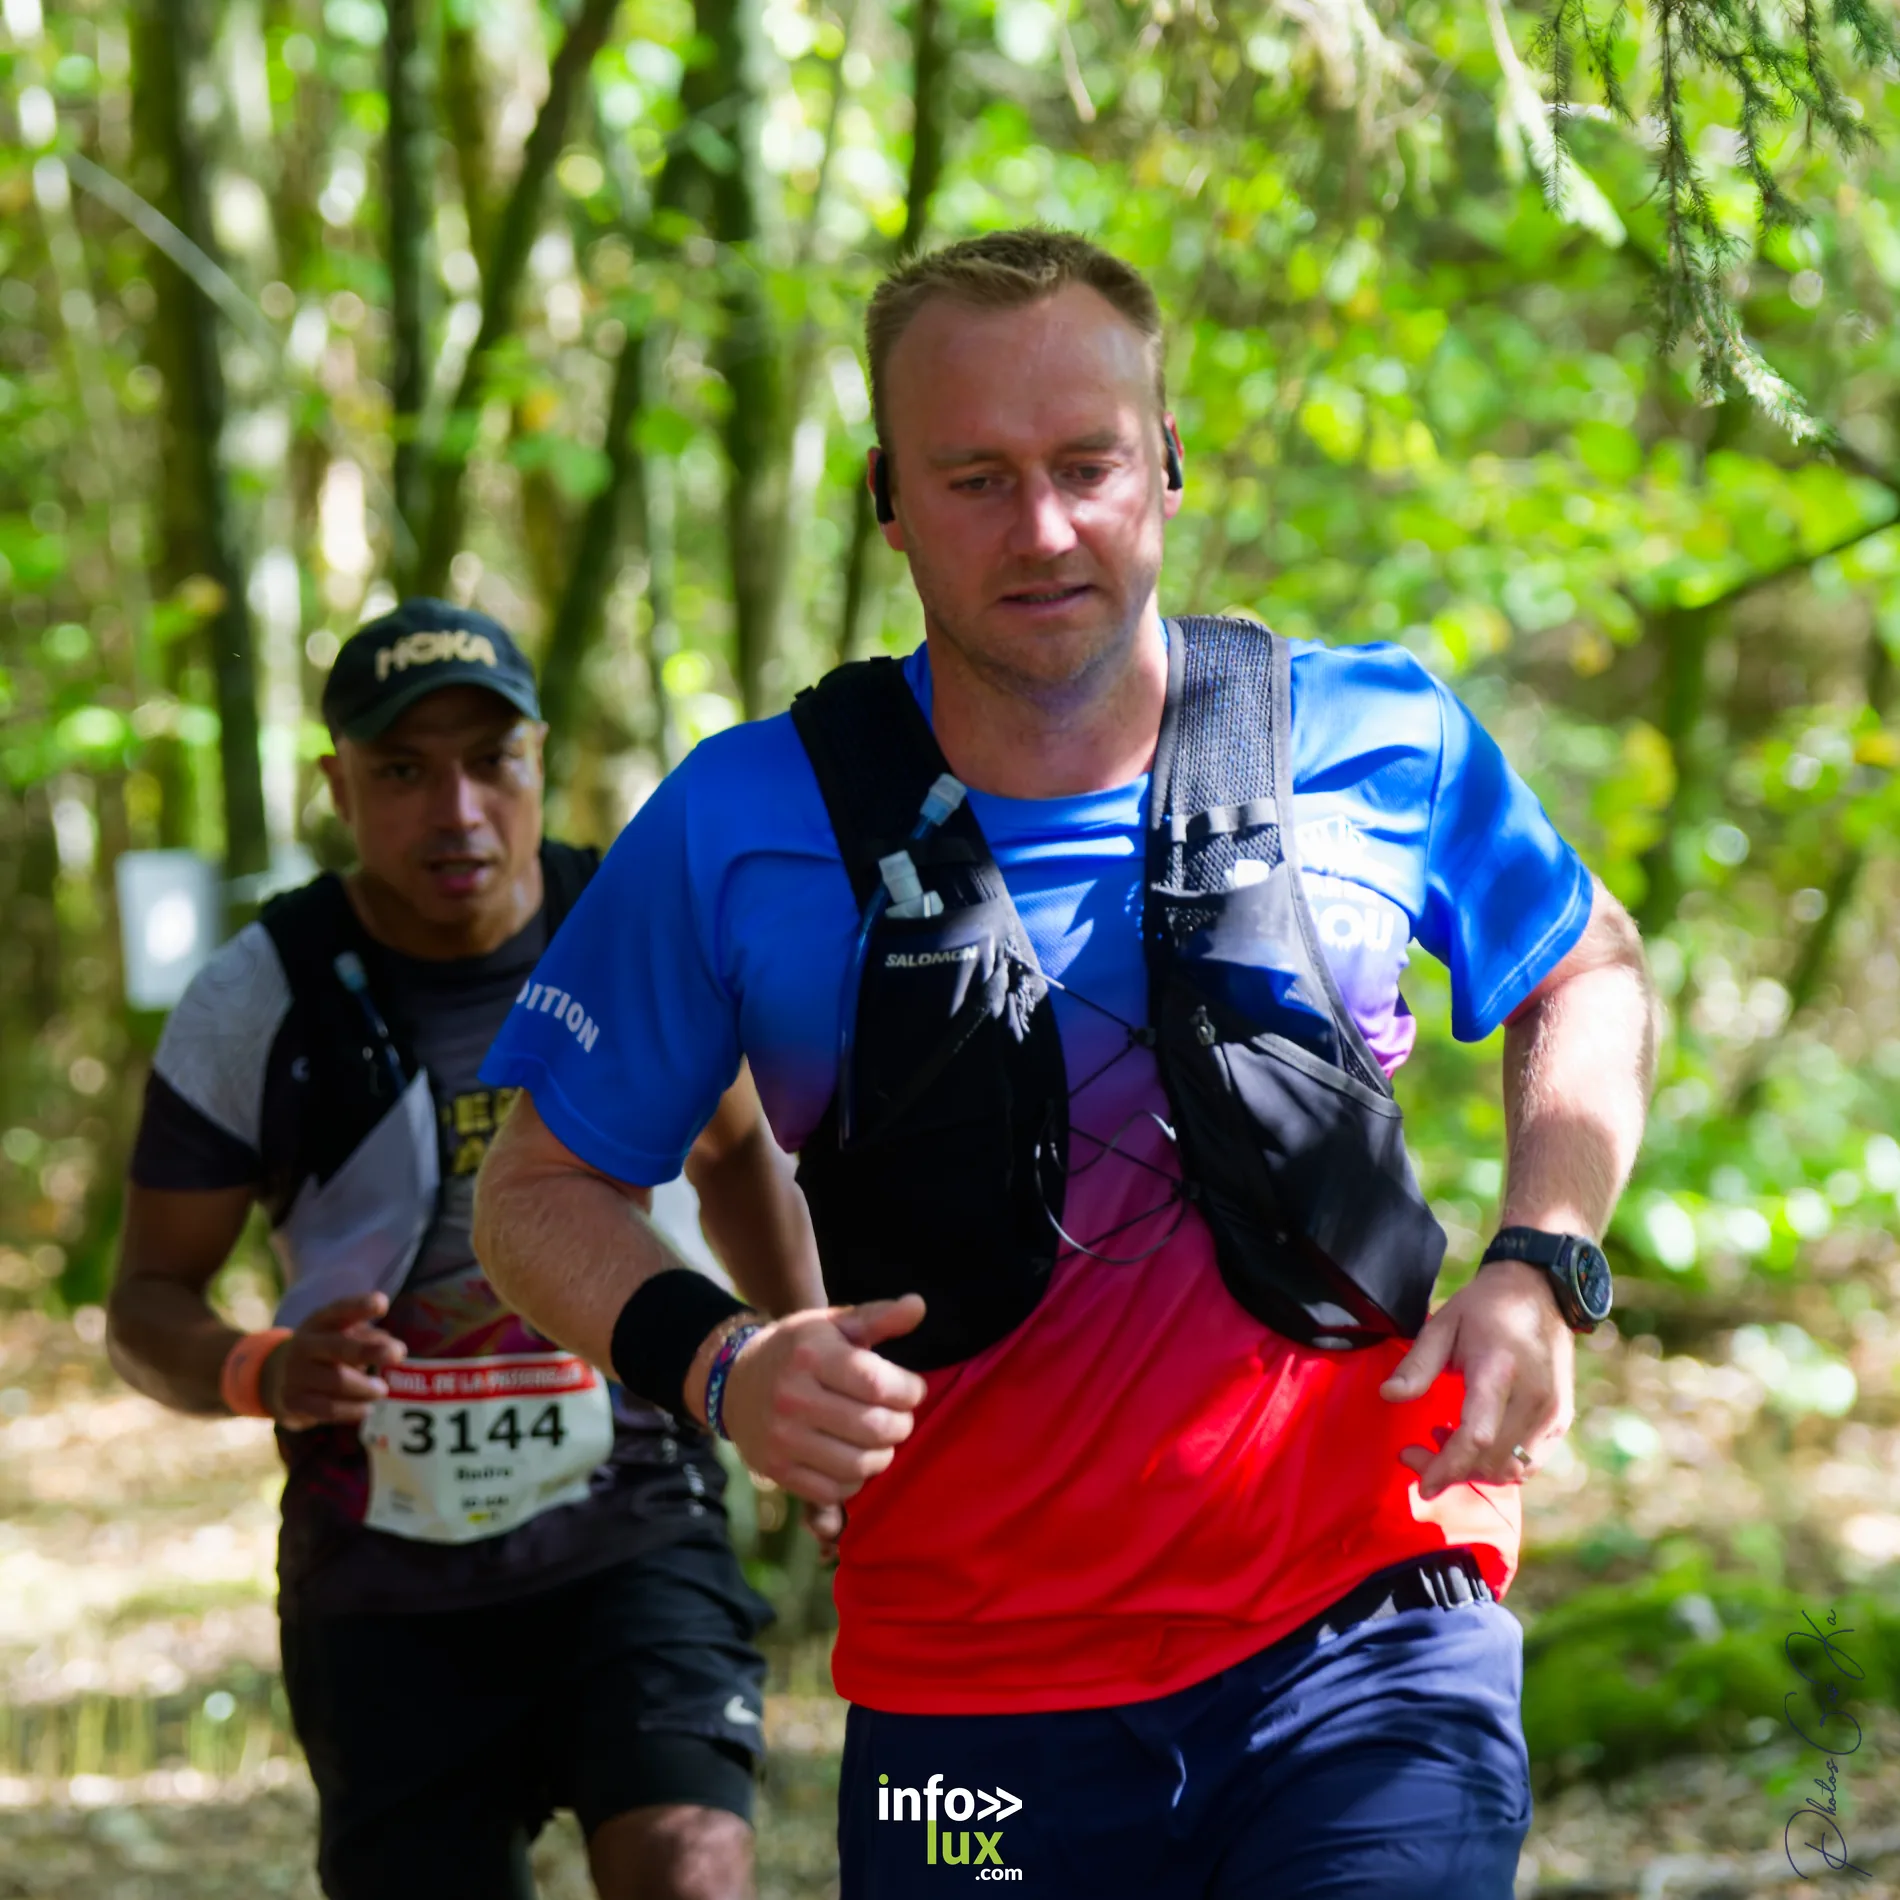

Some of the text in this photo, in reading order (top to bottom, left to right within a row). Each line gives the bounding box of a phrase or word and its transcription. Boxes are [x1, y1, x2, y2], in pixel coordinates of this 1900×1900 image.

[375, 630, 497, 682] HOKA
[1310, 902, 1394, 952] OU
[885, 945, 979, 968] SALOMON
[400, 1401, 568, 1455] 3144
